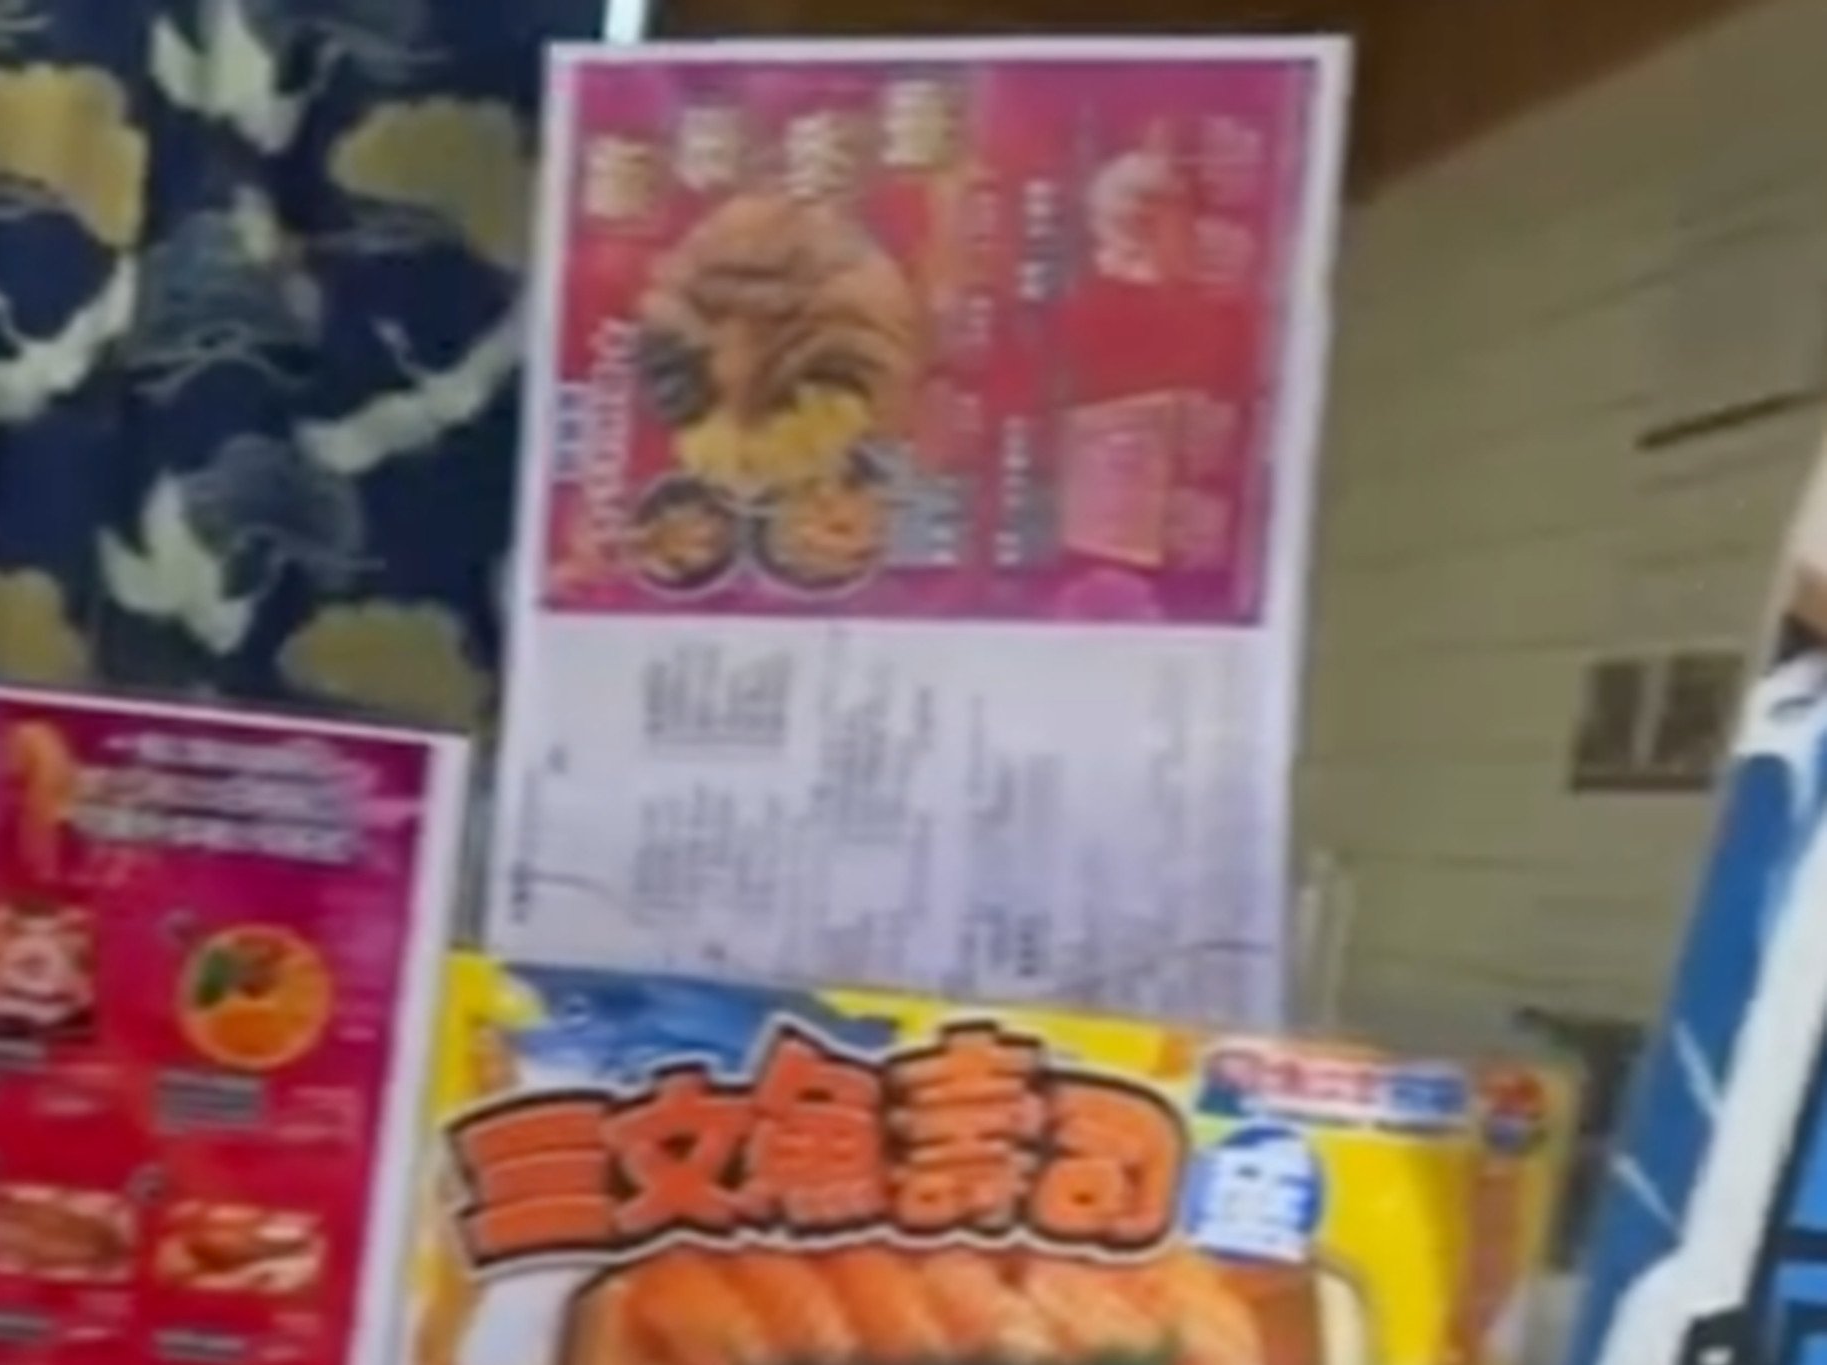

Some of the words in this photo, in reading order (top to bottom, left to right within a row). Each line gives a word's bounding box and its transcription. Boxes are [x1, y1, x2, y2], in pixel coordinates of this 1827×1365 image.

[450, 1020, 1180, 1260] 三文魚壽司
